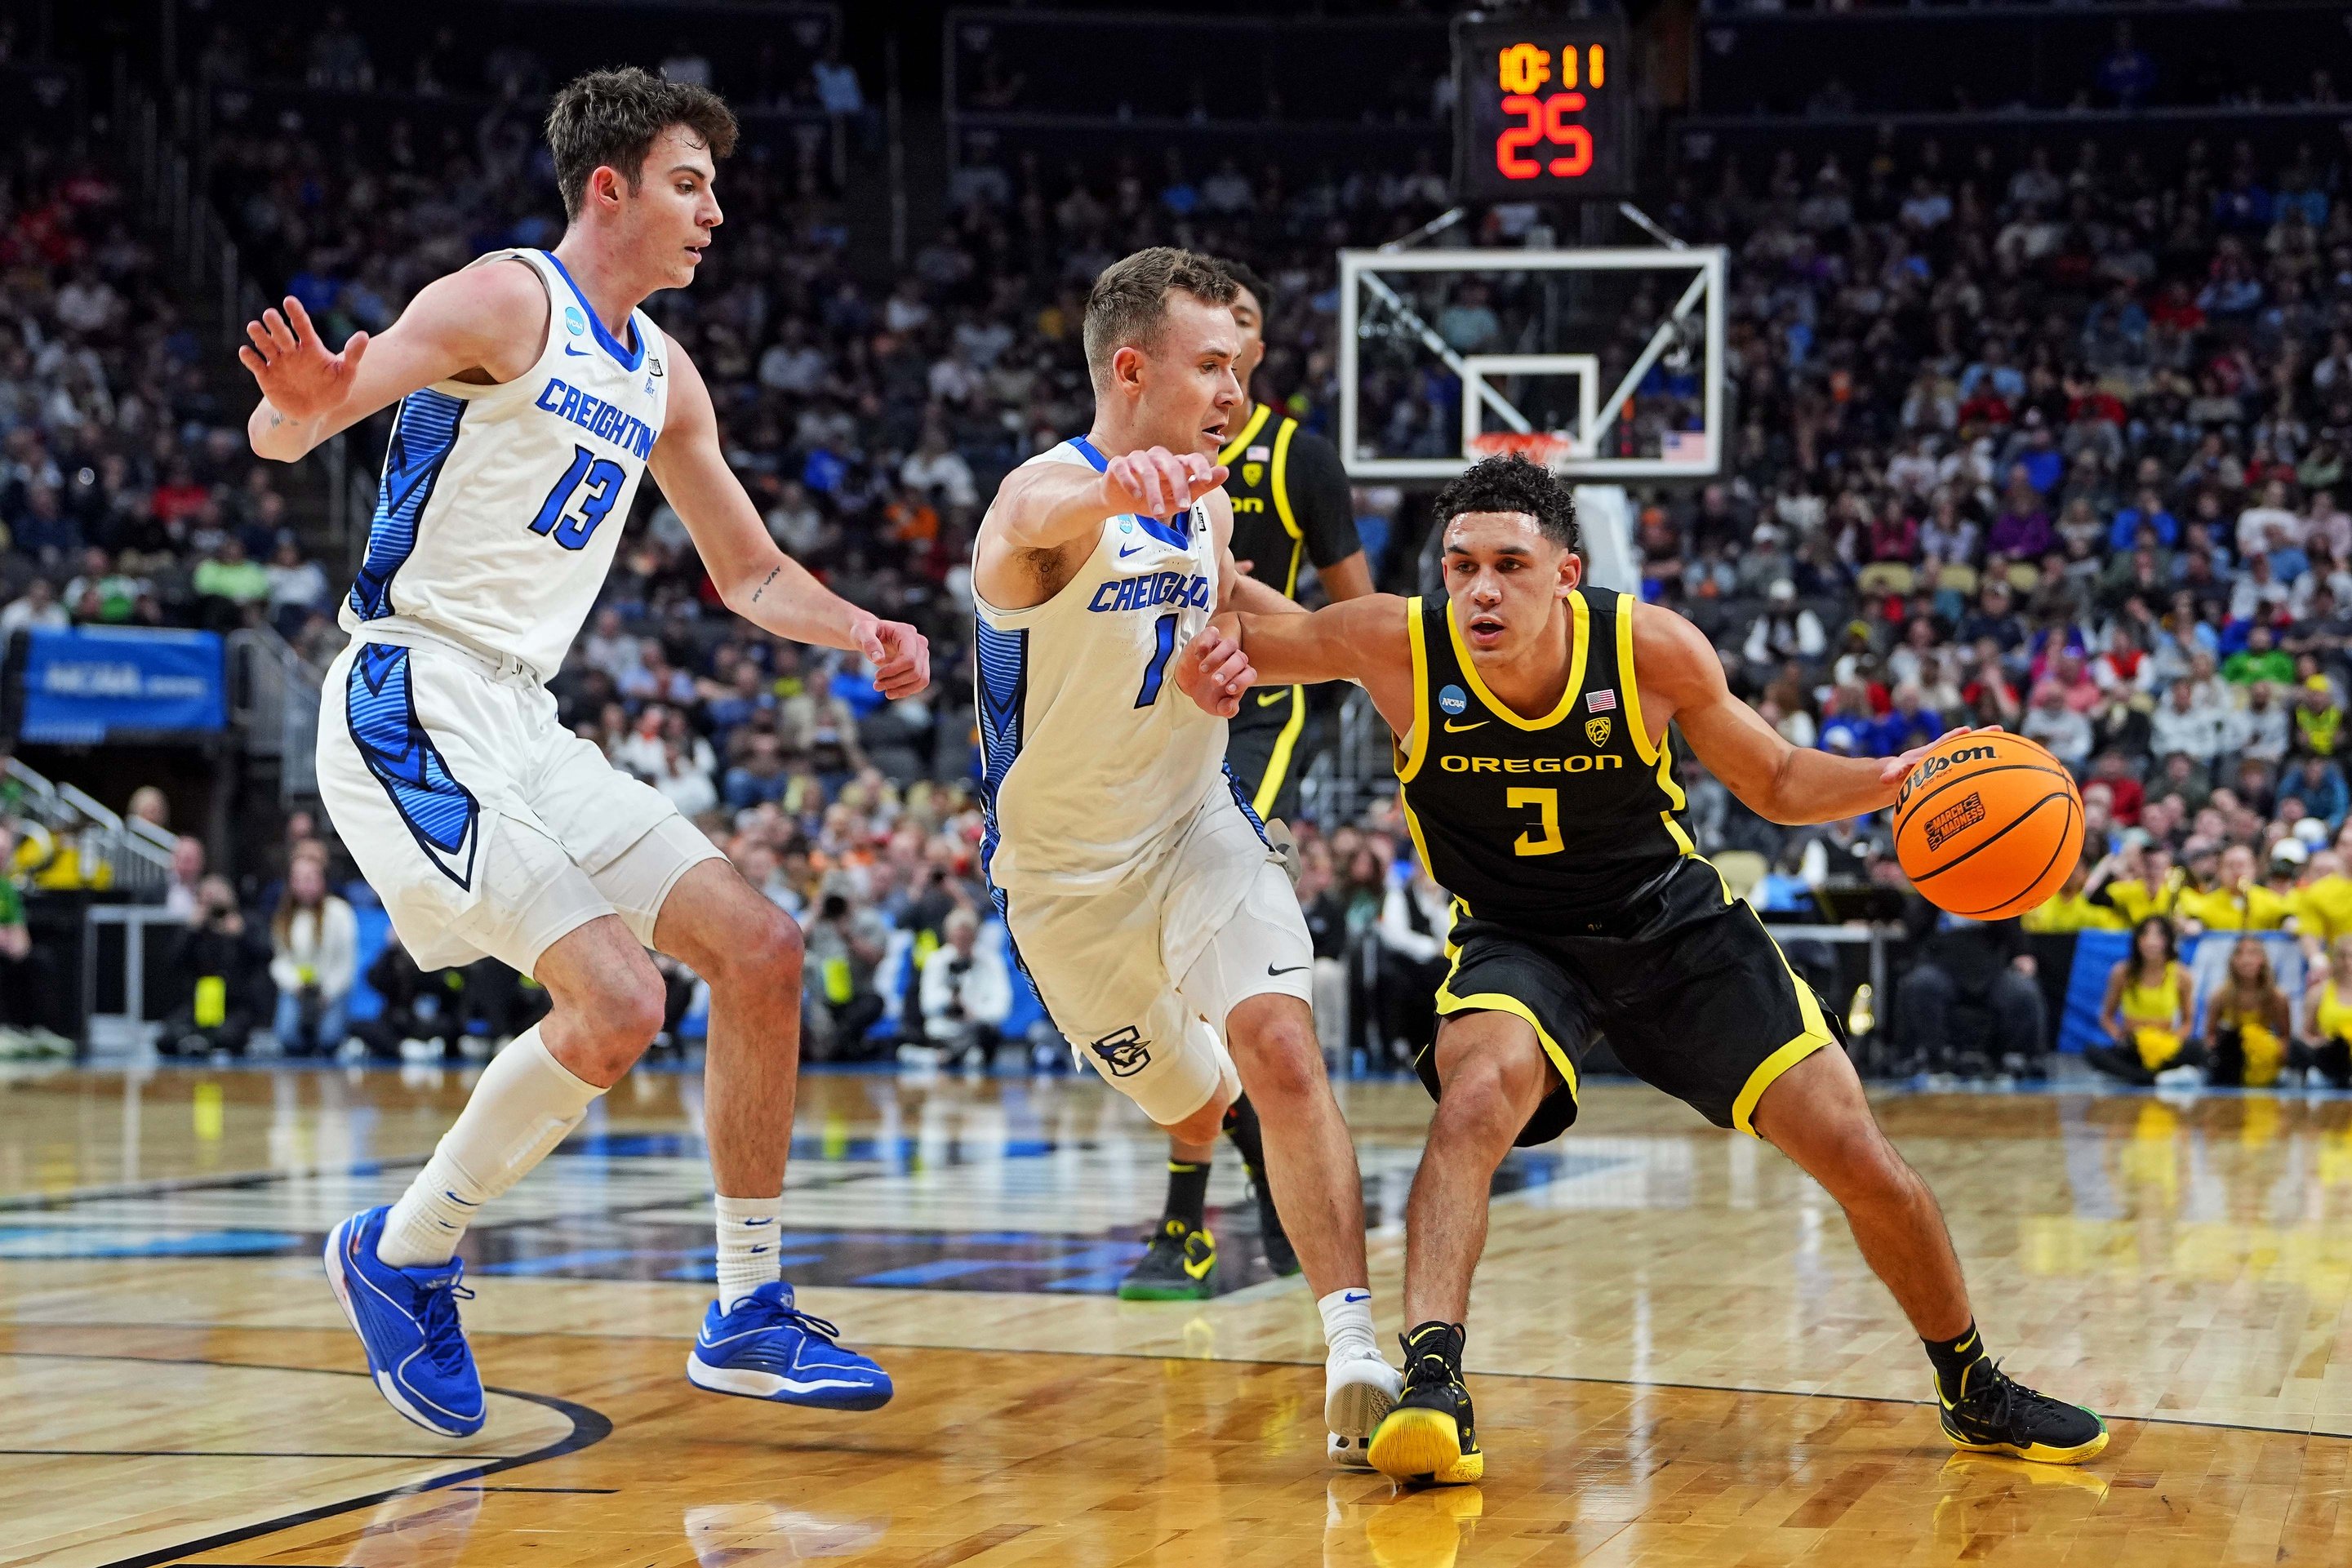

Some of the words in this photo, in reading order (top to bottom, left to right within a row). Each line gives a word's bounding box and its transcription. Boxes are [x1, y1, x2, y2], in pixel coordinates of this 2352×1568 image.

[1500, 43, 1604, 95] 10:11
[1496, 92, 1593, 179] 25
[527, 443, 626, 550] 13
[763, 566, 780, 585] WAY
[1087, 571, 1209, 612] CREIGHO
[1134, 613, 1180, 709] 1
[1442, 697, 1465, 708] NCAA
[1588, 719, 1609, 737] PAC
[1593, 731, 1605, 742] 12
[1440, 755, 1623, 773] OREGON
[1896, 745, 1997, 815] Wilson
[1506, 787, 1566, 856] 3
[1932, 802, 1965, 829] MARCH
[1941, 805, 1985, 837] MADNESS
